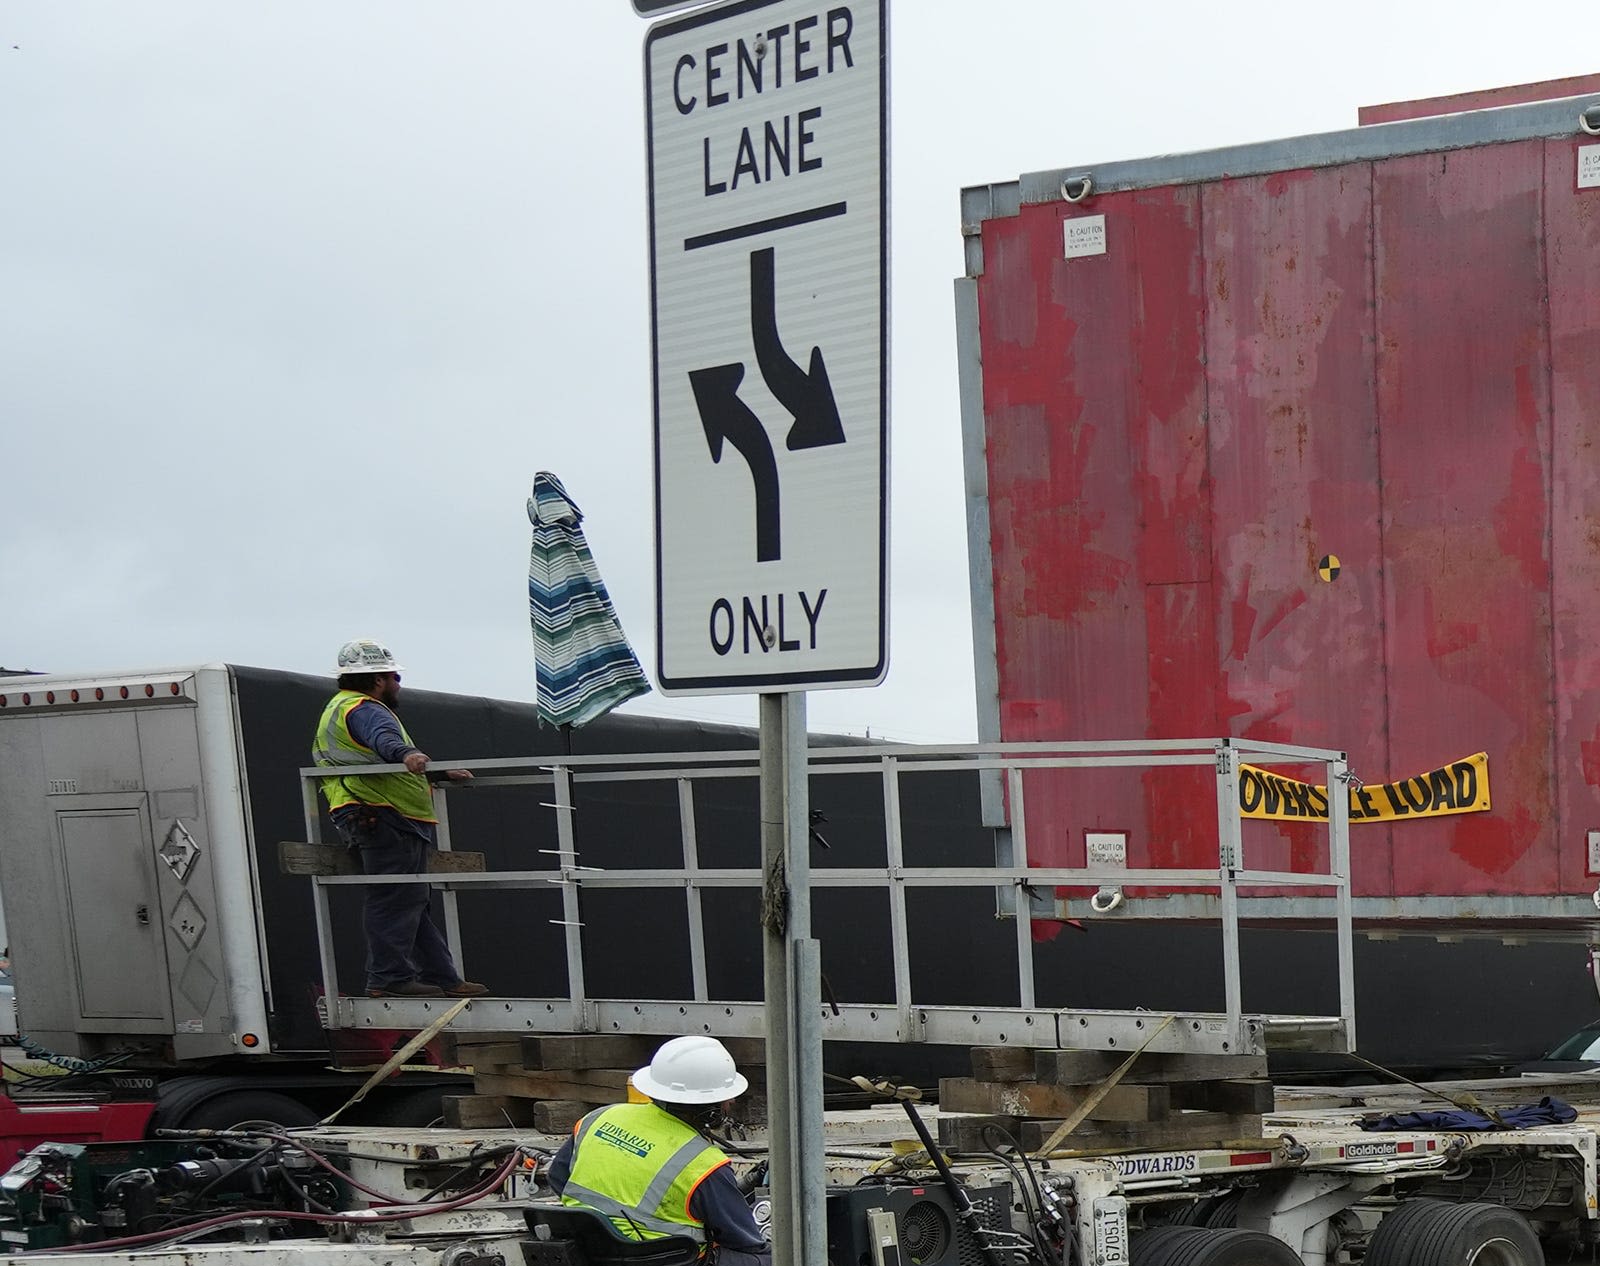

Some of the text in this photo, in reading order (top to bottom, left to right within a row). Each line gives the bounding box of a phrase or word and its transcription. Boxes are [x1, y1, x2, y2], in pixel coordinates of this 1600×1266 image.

[673, 6, 855, 116] CENTER
[704, 106, 823, 197] LANE
[709, 588, 828, 657] ONLY
[1383, 762, 1477, 815] LOAD
[112, 1077, 153, 1088] VOLVO
[600, 1122, 656, 1151] EDWARDS
[1348, 1144, 1396, 1156] Goldhofer
[1117, 1155, 1195, 1177] EDWARDS
[1103, 1210, 1120, 1262] 67051T
